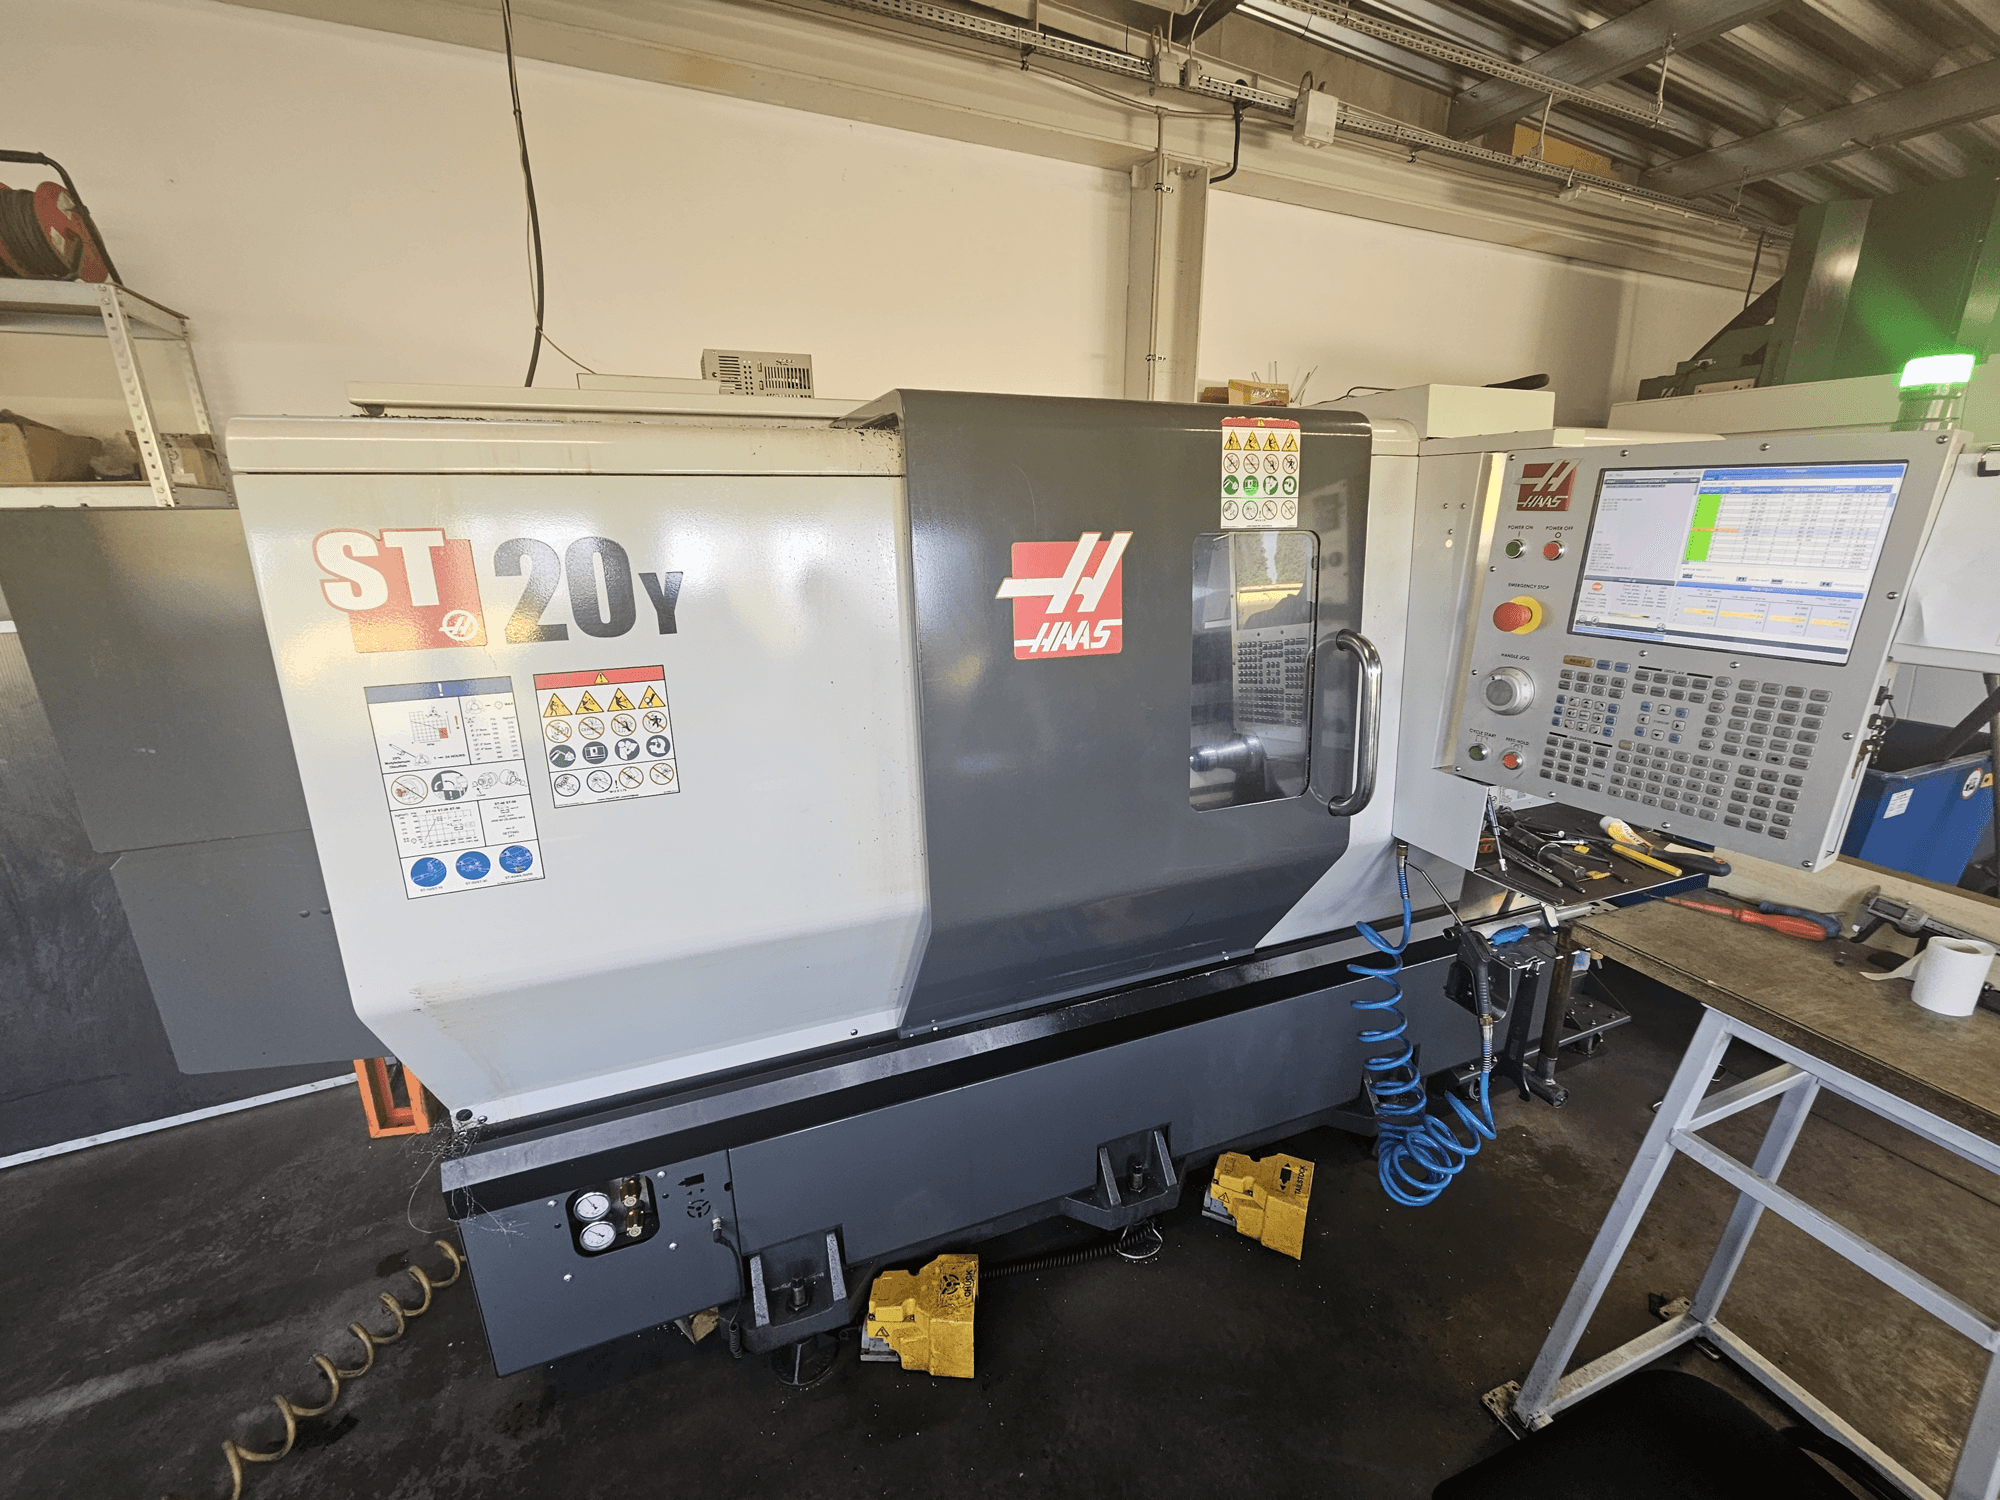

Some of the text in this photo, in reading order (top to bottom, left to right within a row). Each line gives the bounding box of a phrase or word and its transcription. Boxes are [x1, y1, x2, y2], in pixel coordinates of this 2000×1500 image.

[1517, 495, 1568, 508] HAAS
[312, 528, 446, 613] ST
[1014, 618, 1122, 654] HAAS
[1569, 735, 1591, 743] OVERRIDES
[1294, 1164, 1307, 1195] TAILSTOCK
[964, 1270, 973, 1297] CHUCK
